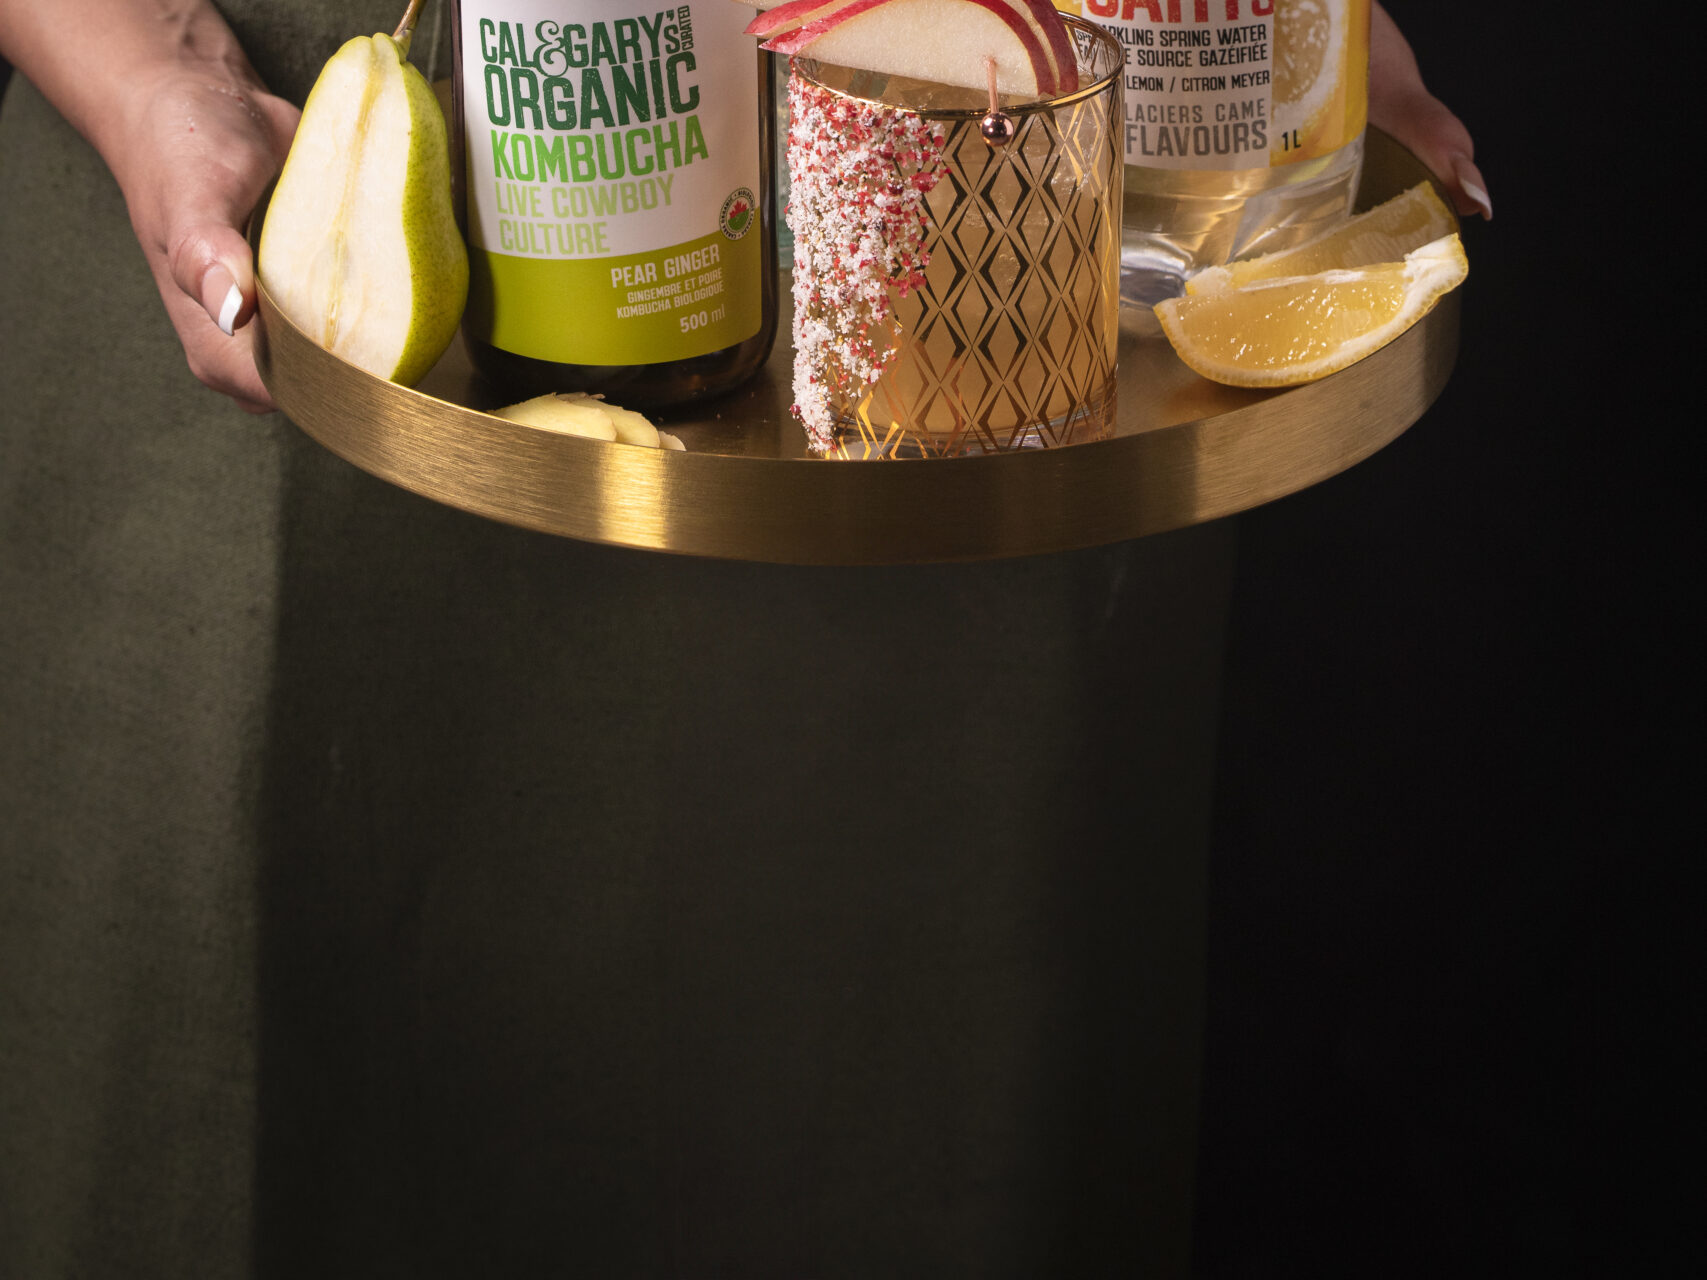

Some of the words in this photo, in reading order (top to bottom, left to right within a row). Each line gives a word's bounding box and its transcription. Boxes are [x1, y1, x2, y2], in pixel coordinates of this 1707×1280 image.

[677, 5, 694, 51] CURATED
[1160, 29, 1211, 48] SPRING
[1216, 23, 1267, 45] WATER
[1137, 49, 1193, 67] SOURCE
[1199, 42, 1268, 66] GAZÉIFIÉE
[484, 51, 700, 130] ORGANIC
[1126, 75, 1164, 91] LEMON
[1181, 74, 1226, 92] CITRON
[1231, 70, 1271, 89] MEYER
[1124, 102, 1203, 124] LACIERS
[1215, 98, 1266, 121] CAME
[490, 114, 709, 183] KOMBUCHA
[1126, 119, 1268, 157] FLAVOURS
[495, 181, 545, 218] LIVE
[551, 173, 674, 219] COWBOY
[499, 219, 611, 255] CULTURE
[611, 262, 658, 288] PEAR
[663, 243, 720, 279] GINGER
[616, 298, 672, 319] KOMBUCHA
[673, 280, 725, 308] BIOLOGIQUE
[626, 281, 682, 304] GINGEMBRE
[684, 277, 697, 292] ET
[698, 267, 723, 287] POIRE
[680, 310, 708, 334] 500
[711, 303, 726, 323] ml
